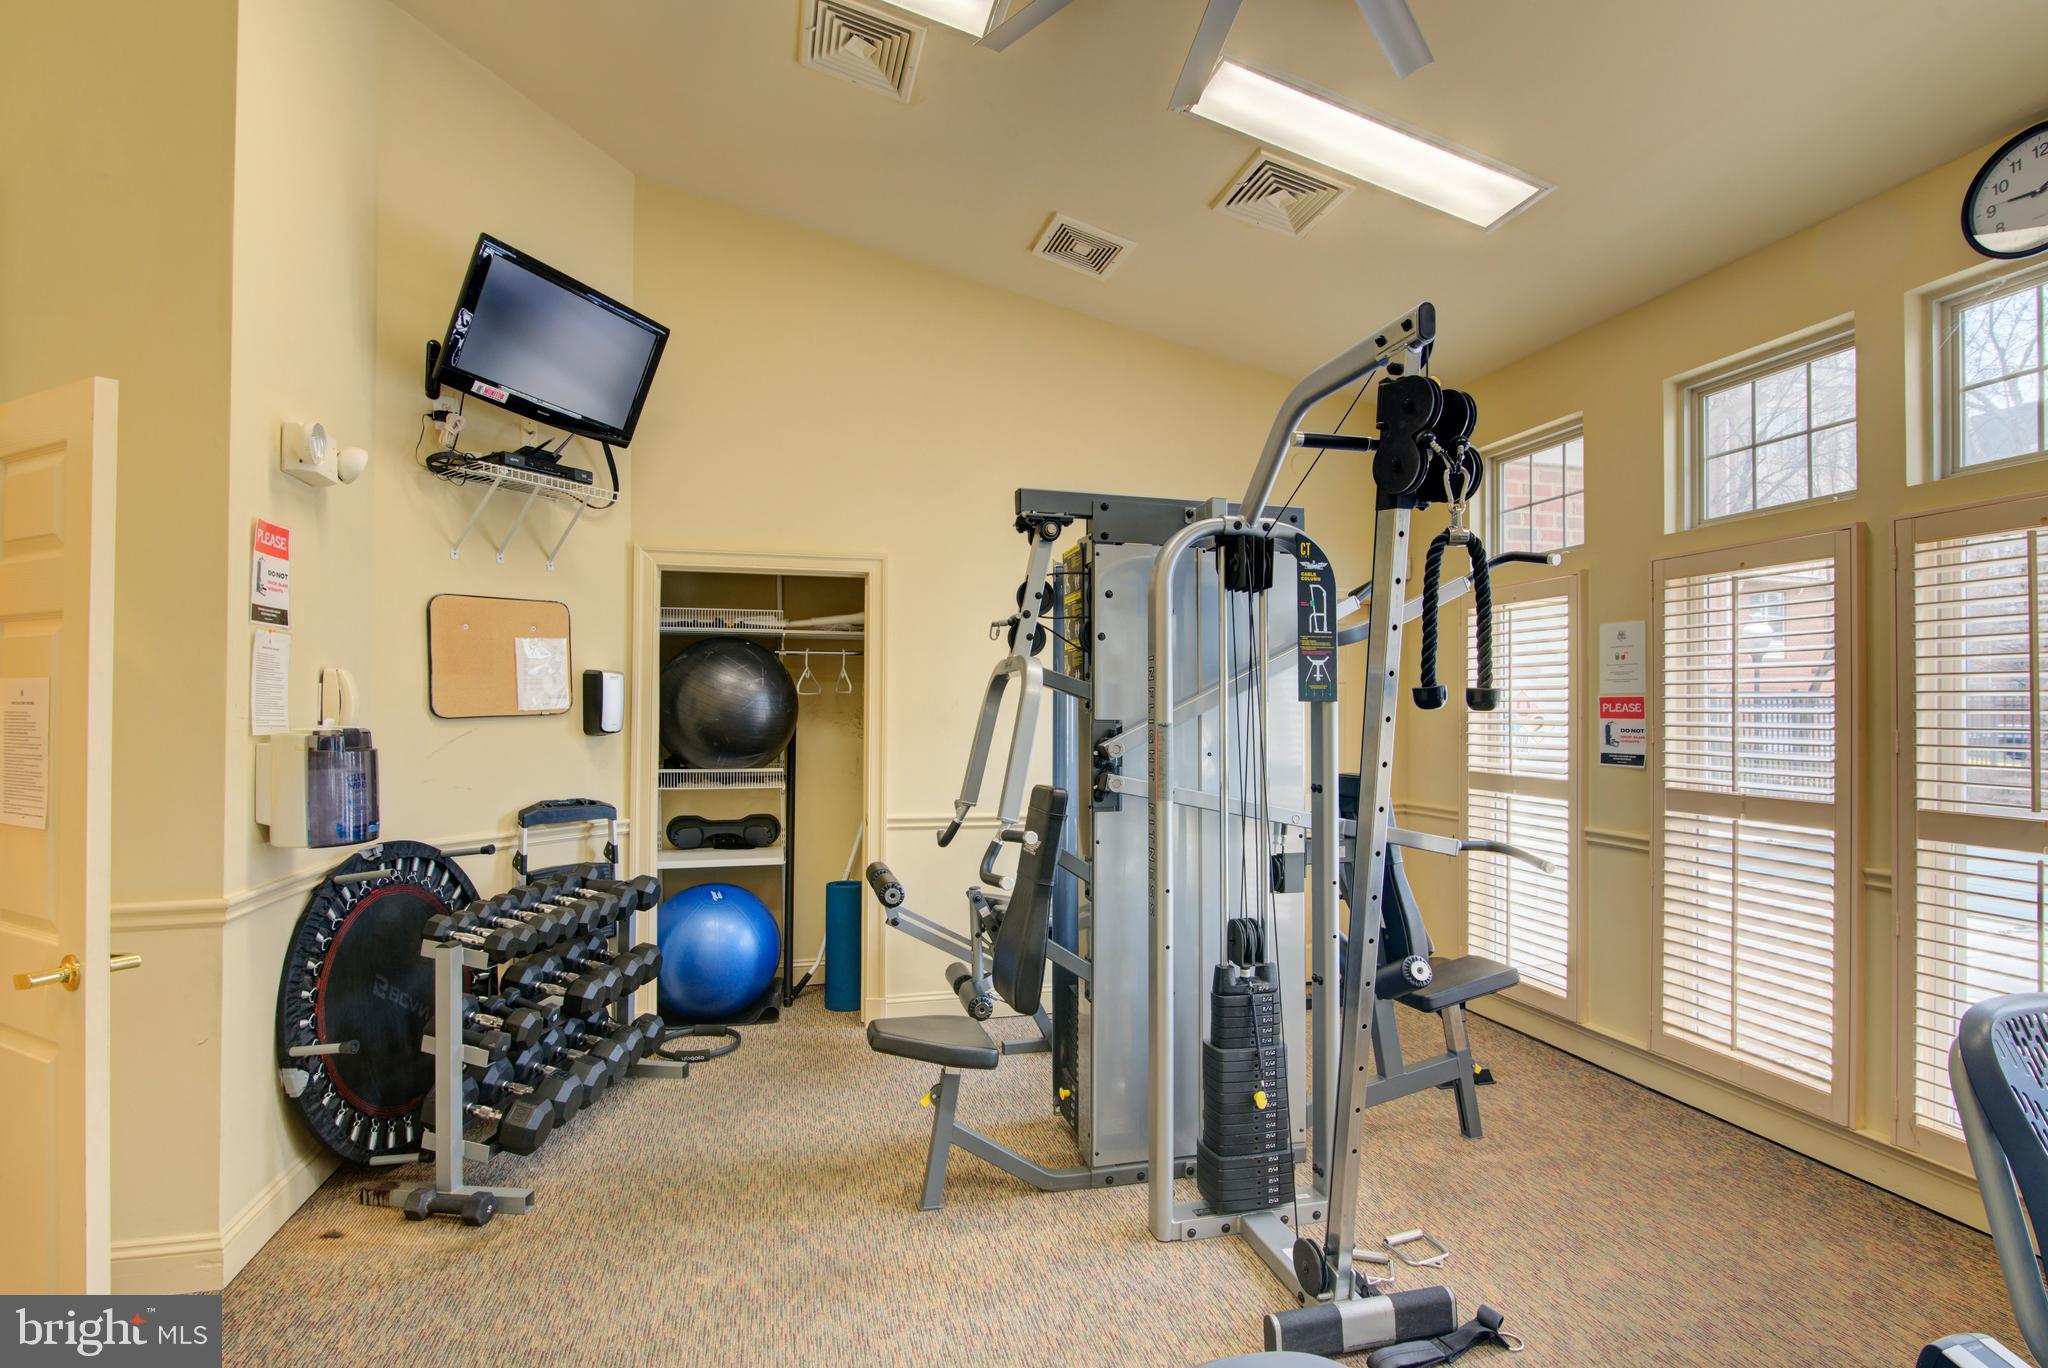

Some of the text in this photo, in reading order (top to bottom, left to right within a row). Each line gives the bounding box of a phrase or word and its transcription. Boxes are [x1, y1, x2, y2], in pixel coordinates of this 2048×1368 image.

[2032, 142, 2048, 159] 12
[2009, 158, 2022, 174] 11
[1992, 179, 2009, 196] 10
[1986, 205, 1996, 218] 9
[1995, 222, 2005, 233] 8
[256, 528, 288, 551] PLEASE
[1300, 542, 1311, 556] CT
[267, 569, 289, 580] DO NOT
[1602, 703, 1642, 713] PLEASE
